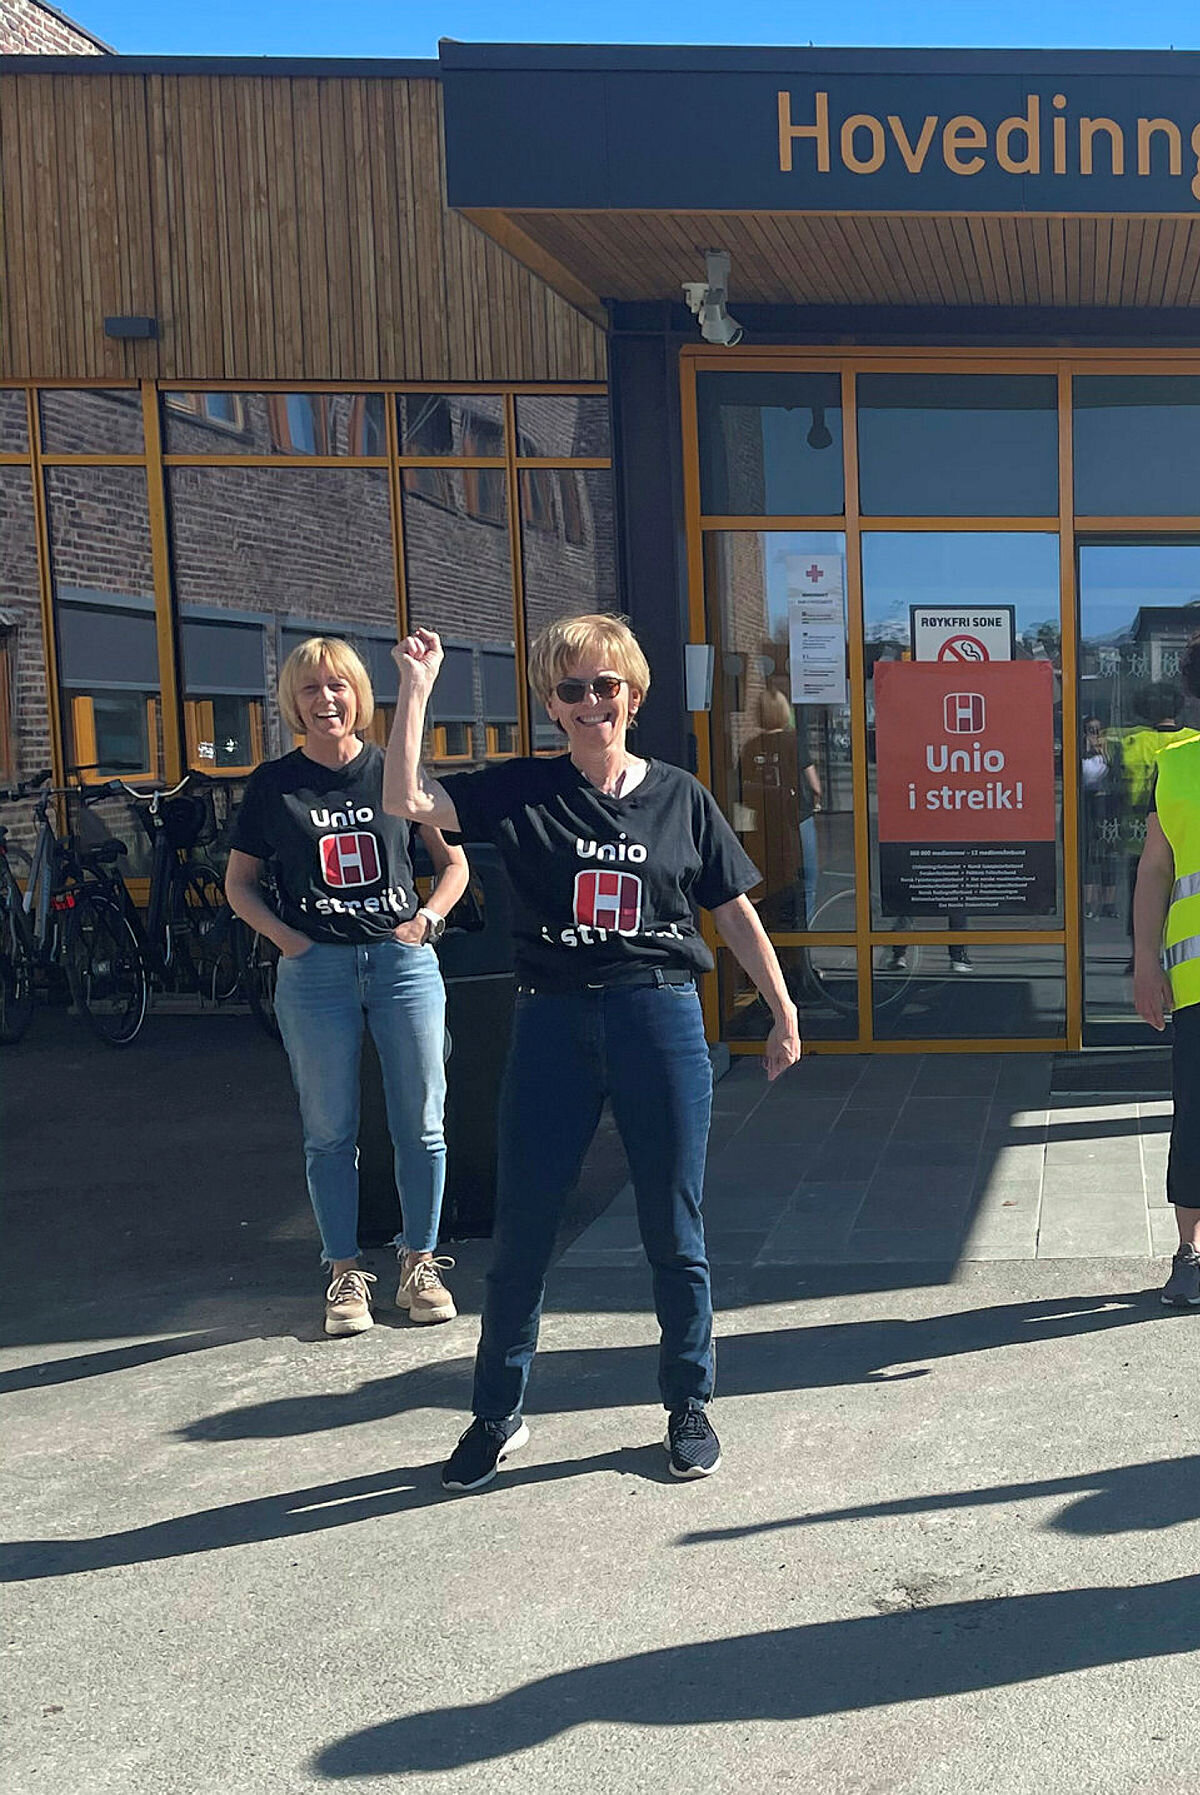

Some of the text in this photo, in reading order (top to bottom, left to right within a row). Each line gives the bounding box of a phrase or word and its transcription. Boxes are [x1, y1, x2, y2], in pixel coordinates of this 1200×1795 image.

[921, 617, 1002, 627] RØYKFRI SONE
[926, 741, 1005, 773] Unio
[908, 781, 1024, 810] i streik!
[310, 801, 374, 828] Unio
[576, 832, 648, 863] Unio
